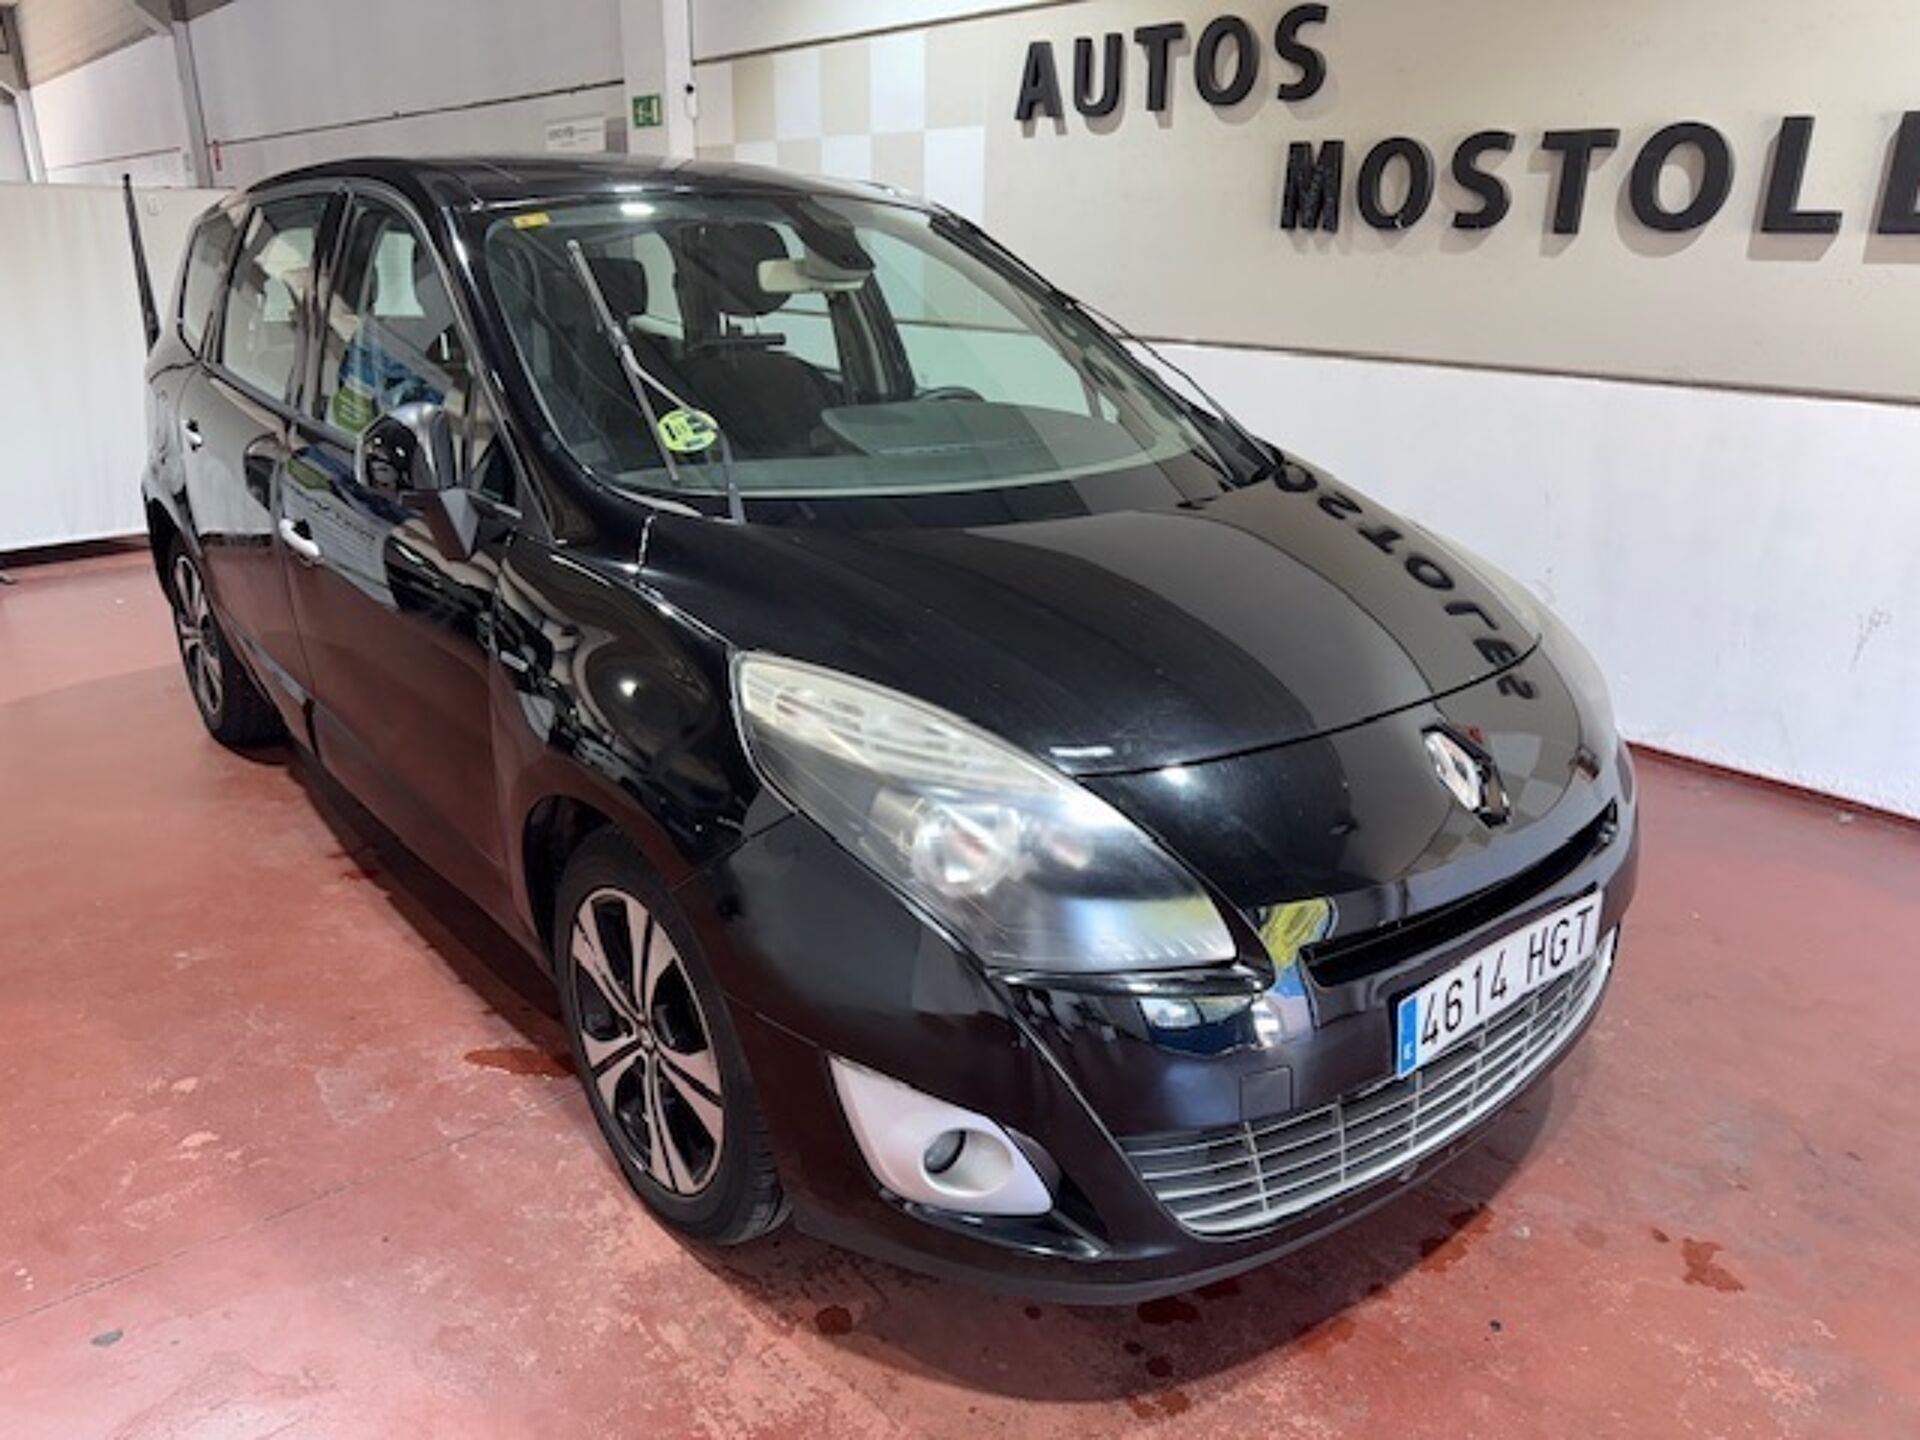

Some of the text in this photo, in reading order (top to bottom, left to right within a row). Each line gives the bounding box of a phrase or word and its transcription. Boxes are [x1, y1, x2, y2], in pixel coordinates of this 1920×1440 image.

[1014, 2, 1330, 121] AUTOS
[1420, 904, 1595, 1047] 4614 HGT
